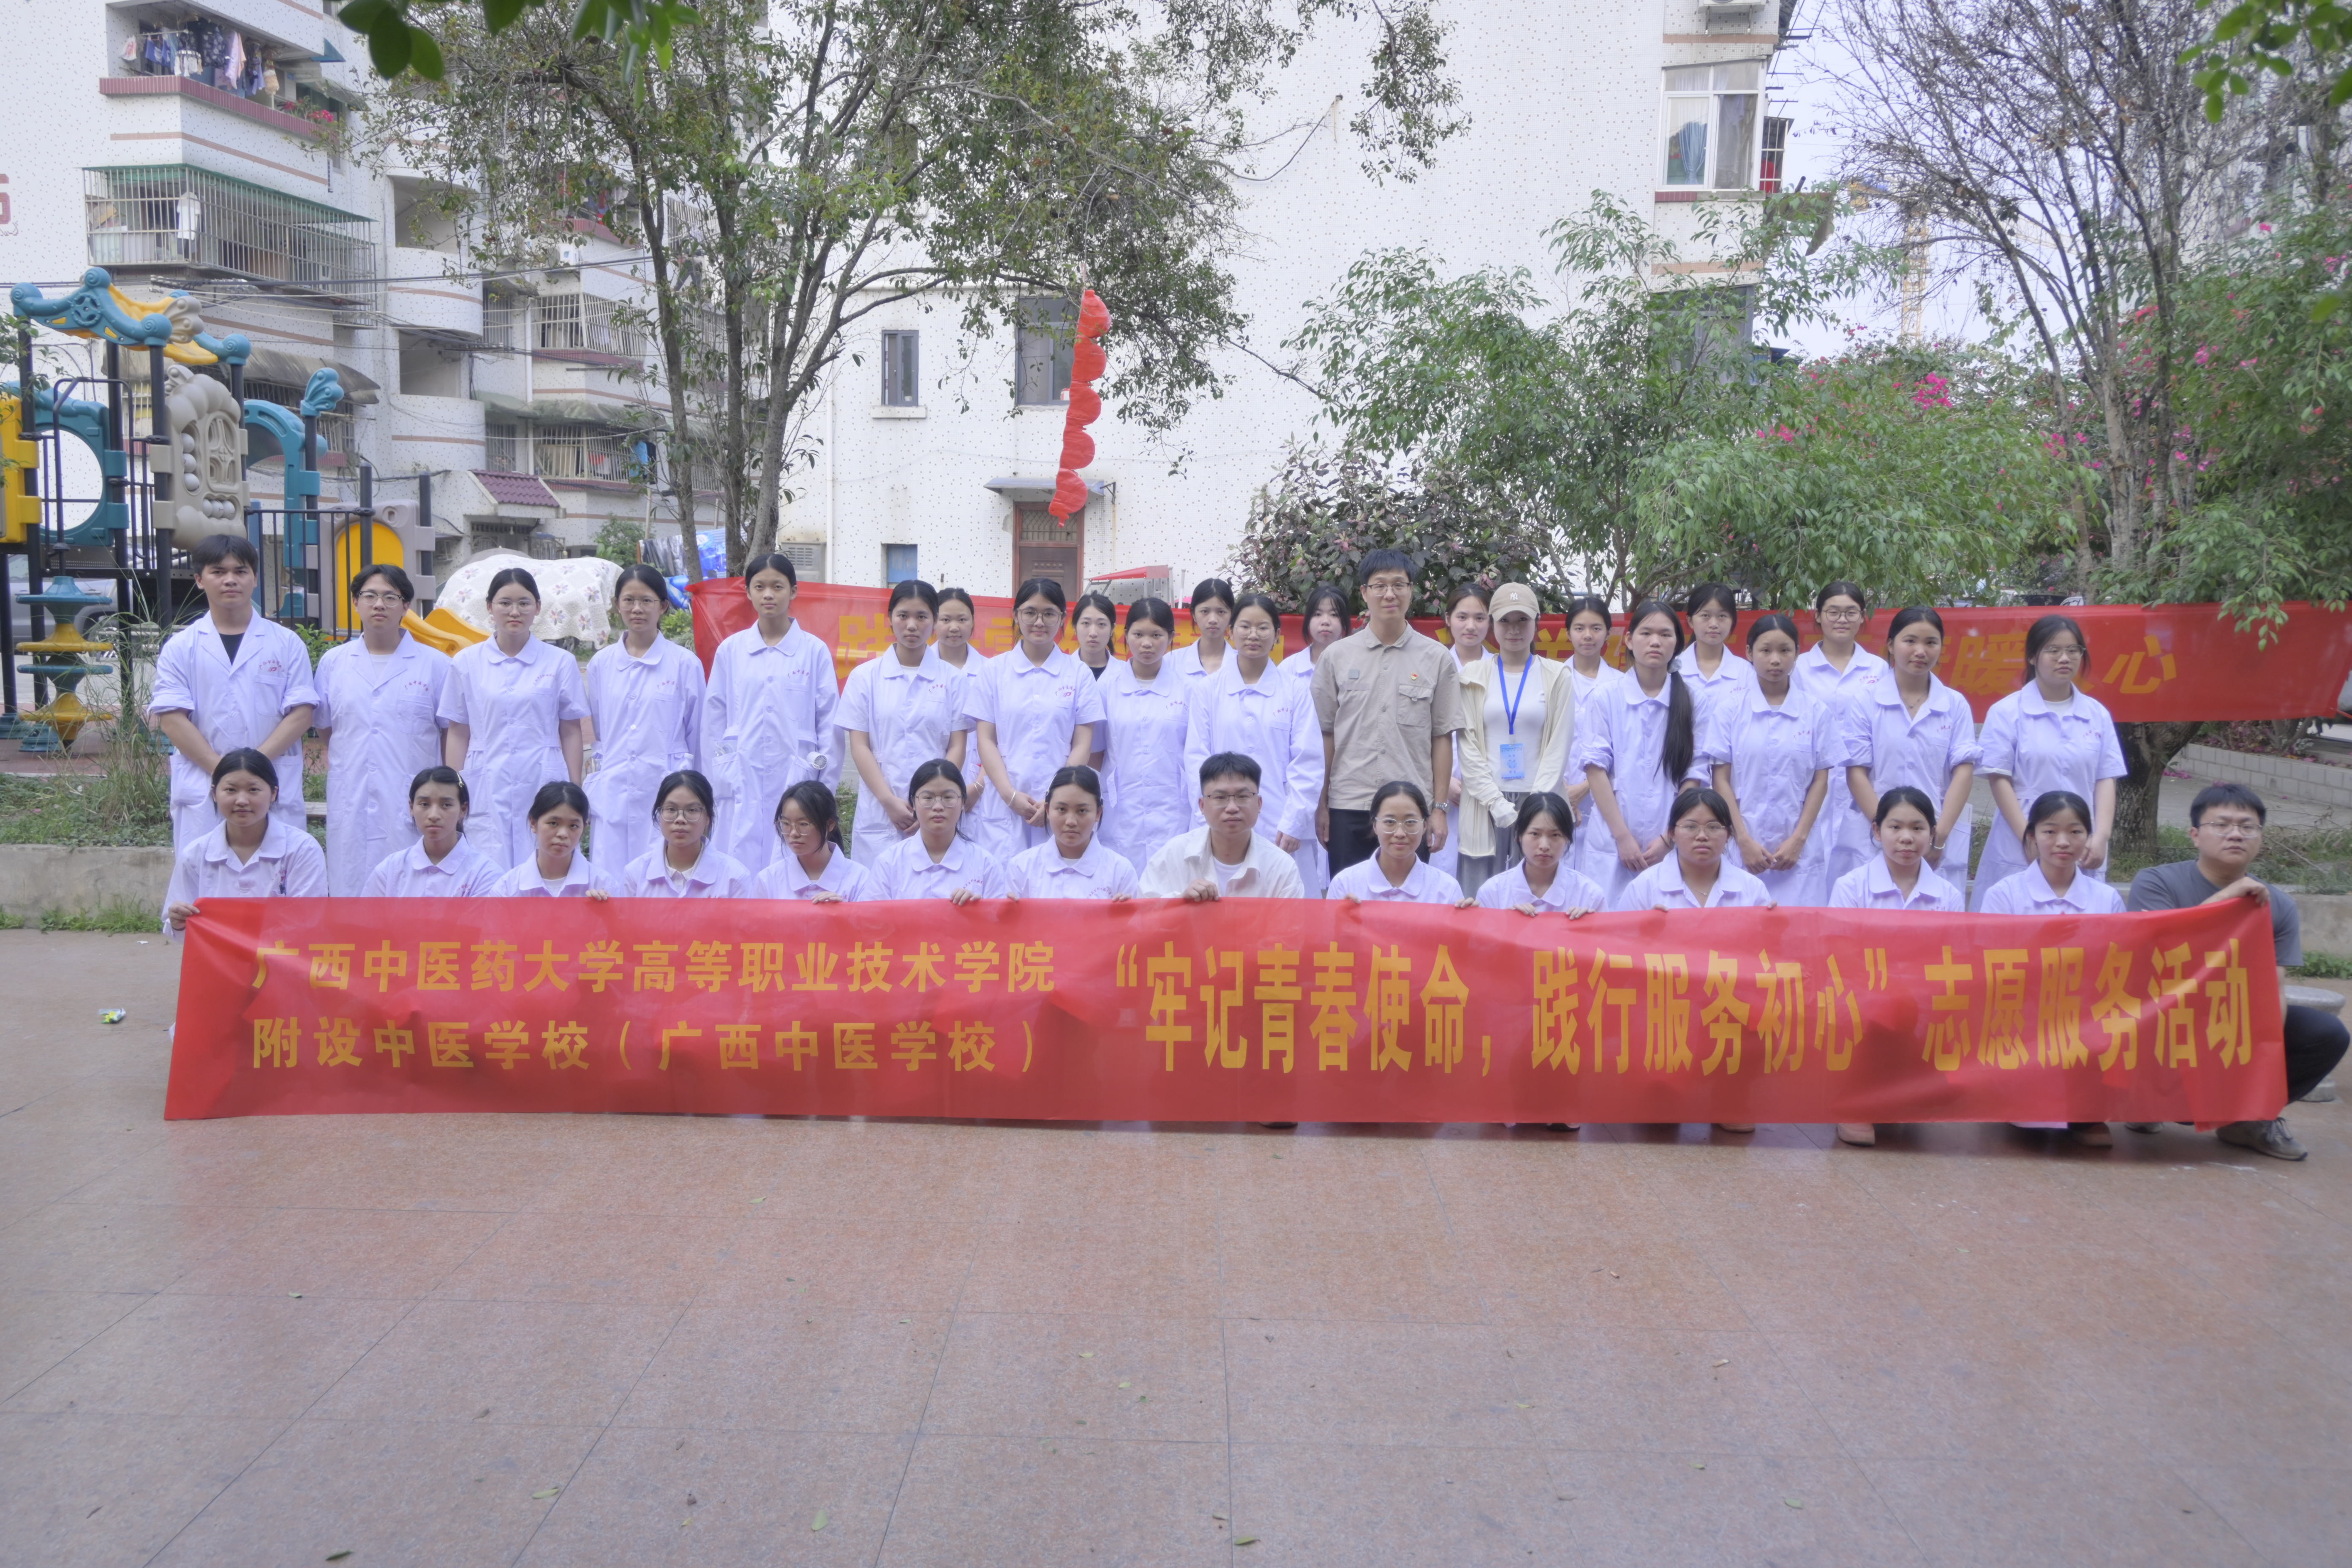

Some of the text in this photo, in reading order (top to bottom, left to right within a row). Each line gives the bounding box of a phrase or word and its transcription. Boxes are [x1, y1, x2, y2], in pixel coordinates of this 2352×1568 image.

[253, 939, 1055, 994] 广西中医药大学高等职业技术学院
[253, 1017, 1034, 1073] 附设中医学校（广西中医学校）
